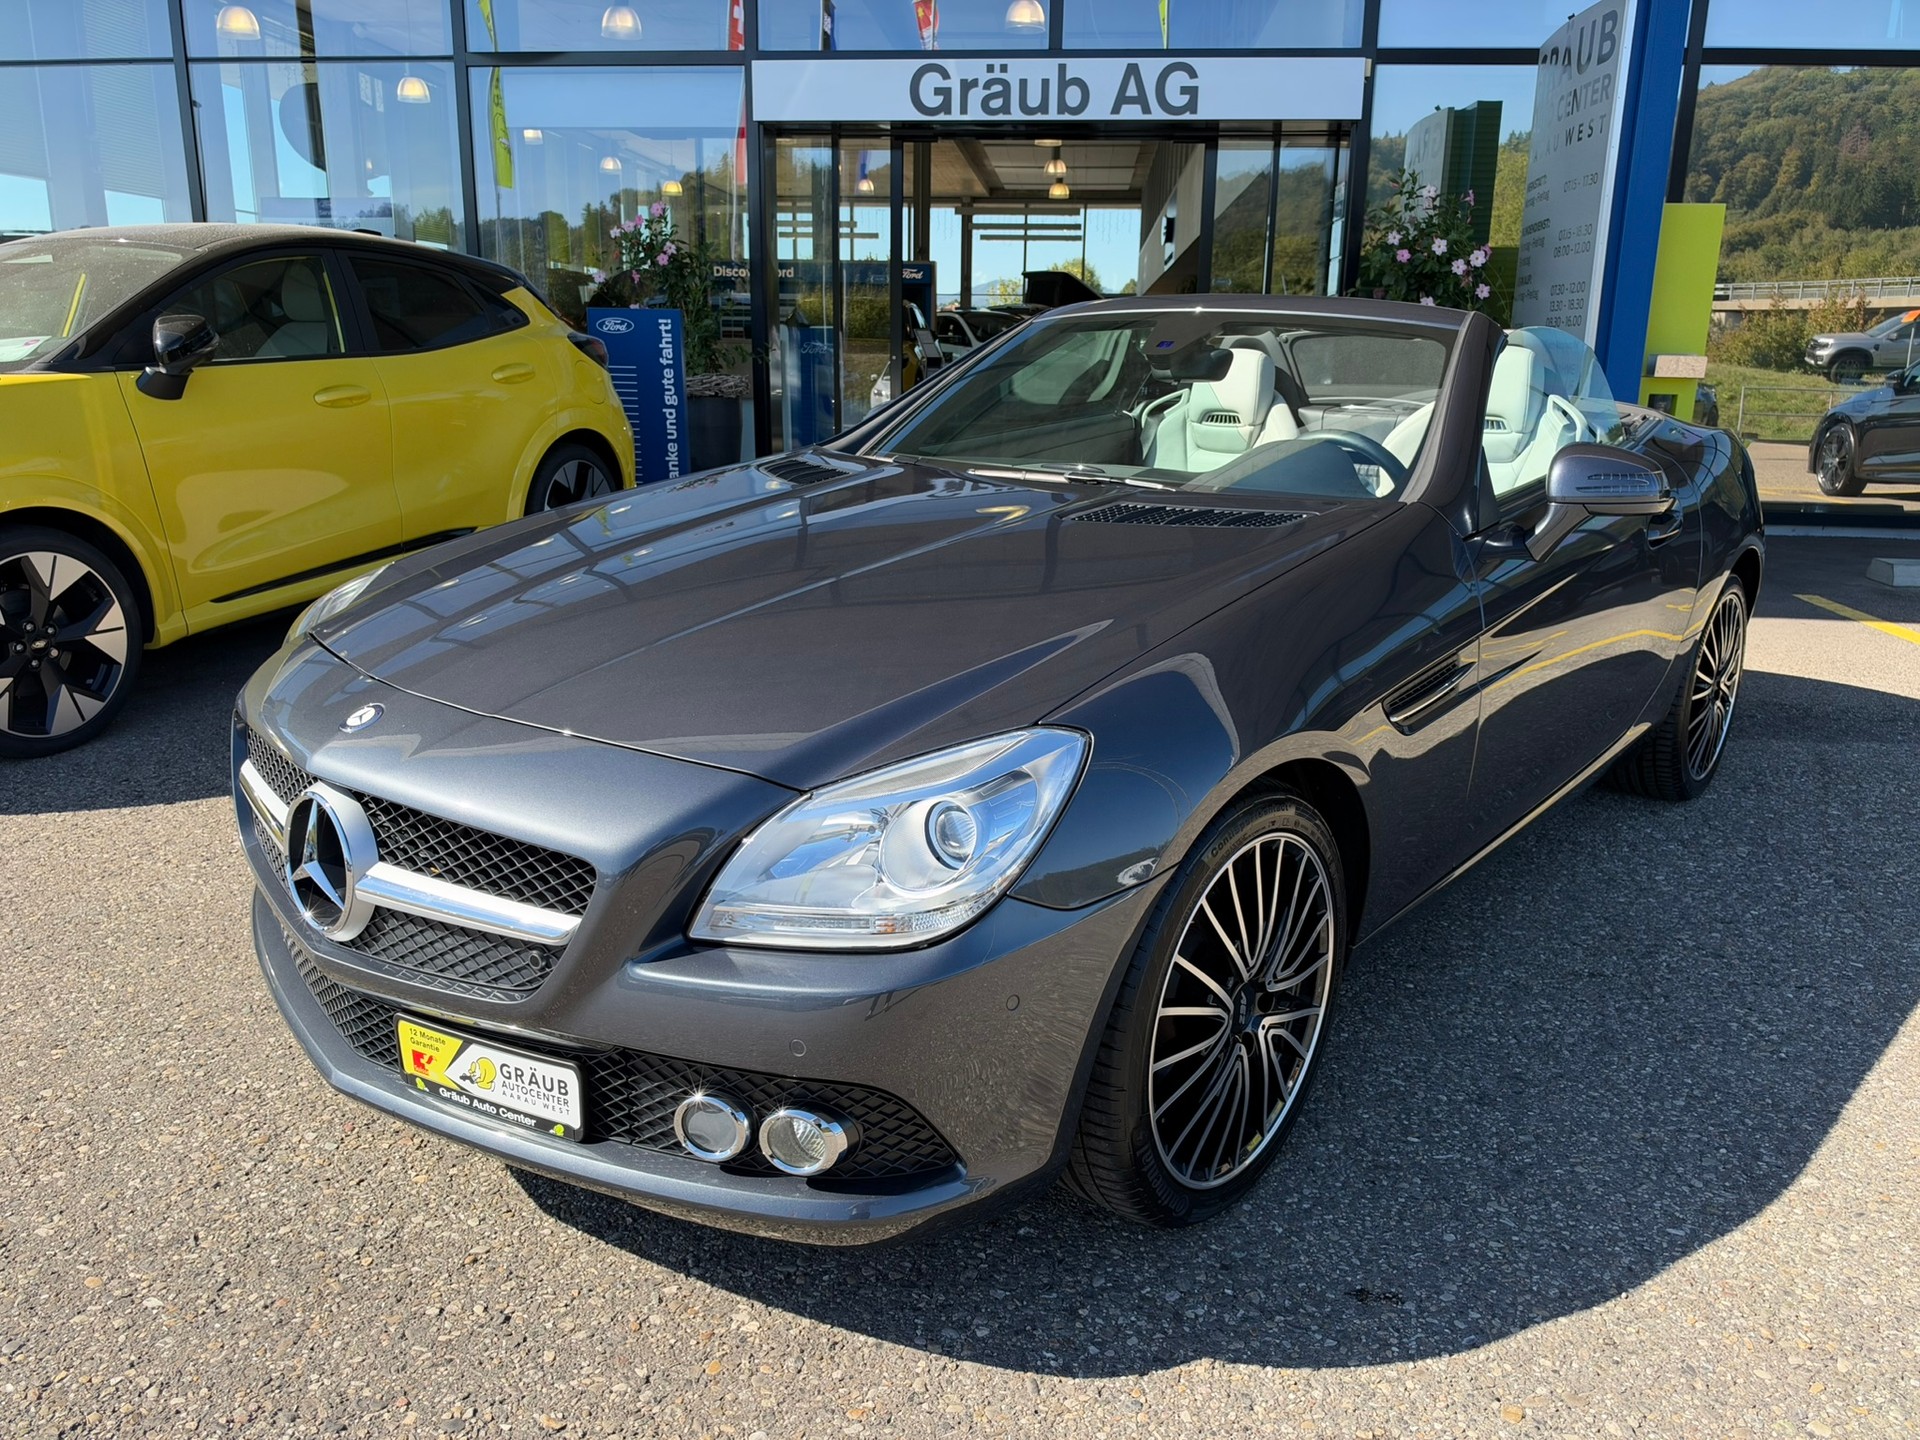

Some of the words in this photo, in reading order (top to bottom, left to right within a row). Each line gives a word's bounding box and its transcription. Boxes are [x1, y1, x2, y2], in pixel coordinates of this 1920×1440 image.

[908, 62, 1090, 117] Gräub
[1110, 61, 1200, 117] AG
[1564, 113, 1607, 147] WEST
[777, 266, 795, 278] ord
[602, 319, 628, 332] Ford
[657, 318, 673, 365] fahrt!
[663, 369, 678, 406] gute
[662, 408, 677, 440] und
[665, 442, 680, 480] anke
[409, 1028, 418, 1036] 12
[419, 1030, 446, 1046] Monate
[409, 1036, 440, 1052] Garantie
[499, 1062, 569, 1097] GRÄUB
[501, 1080, 570, 1108] AUTOCENTER
[439, 1087, 470, 1106] Gräub
[472, 1099, 496, 1115] Auto
[499, 1107, 537, 1127] Center
[502, 1090, 537, 1106] AARAU
[542, 1102, 571, 1116] WEST
